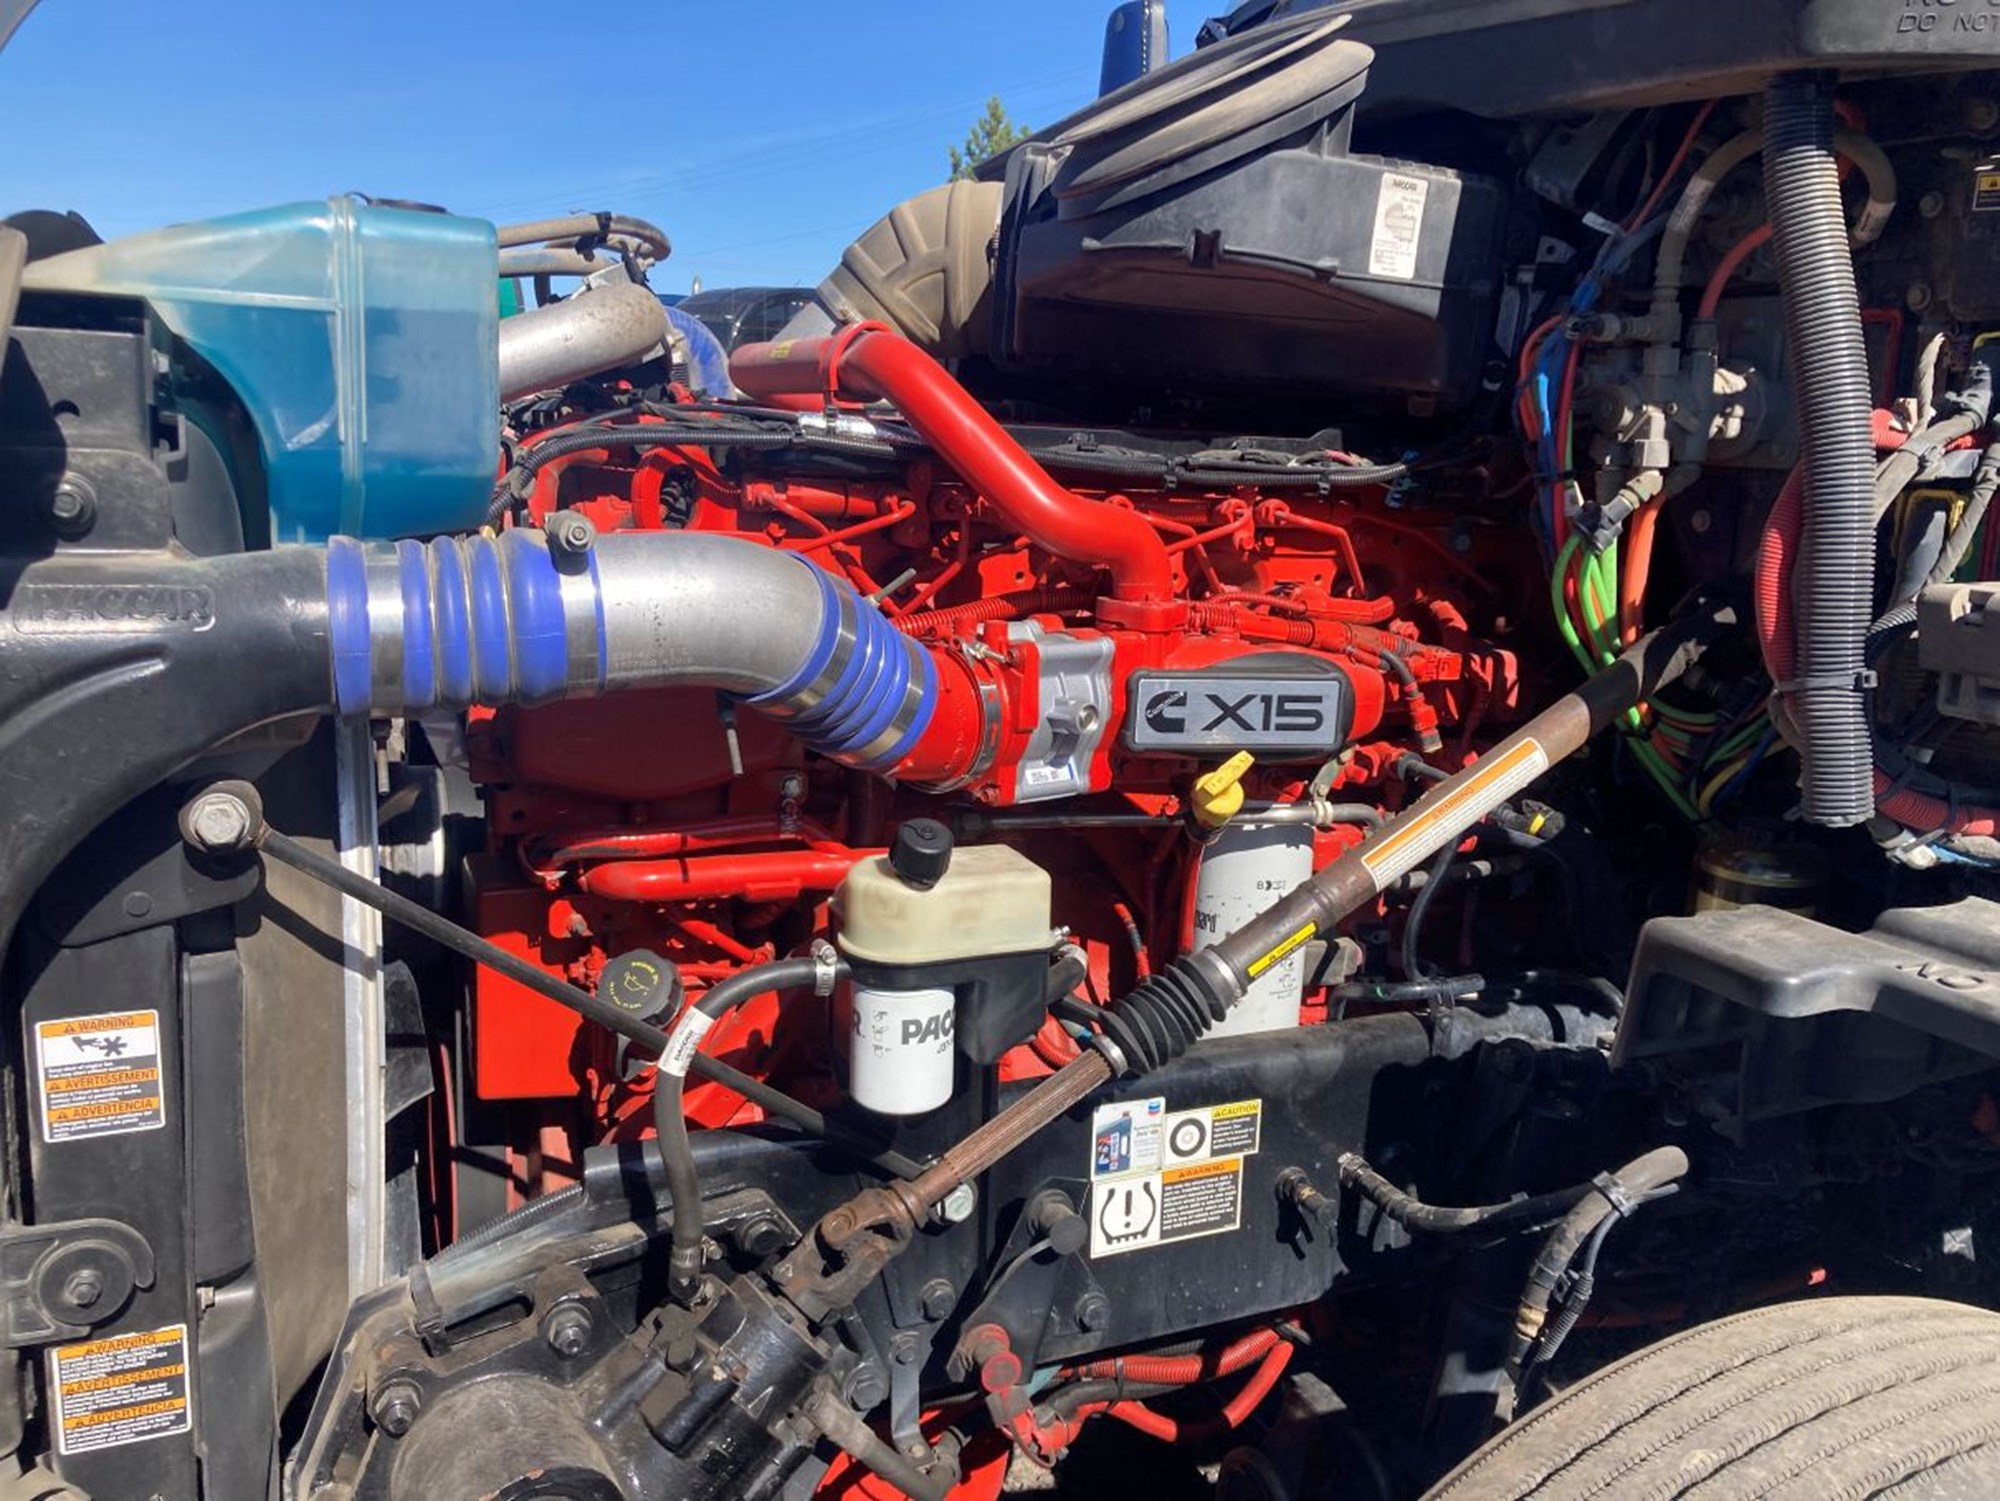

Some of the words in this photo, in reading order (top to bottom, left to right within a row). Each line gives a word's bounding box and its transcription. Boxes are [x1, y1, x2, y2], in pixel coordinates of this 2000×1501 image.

[1897, 12, 1937, 34] DO
[1201, 693, 1325, 732] X15
[78, 1015, 135, 1032] WARNING
[65, 1069, 156, 1090] AVERTISSEMENT
[73, 1098, 153, 1118] ADVERTENCIA
[1221, 1102, 1259, 1116] CAUTION
[1186, 1163, 1226, 1177] WARNING
[94, 1334, 156, 1352] WARNING
[76, 1366, 179, 1389] AVERTISSEMENT
[87, 1400, 176, 1424] ADVERTENCIA
